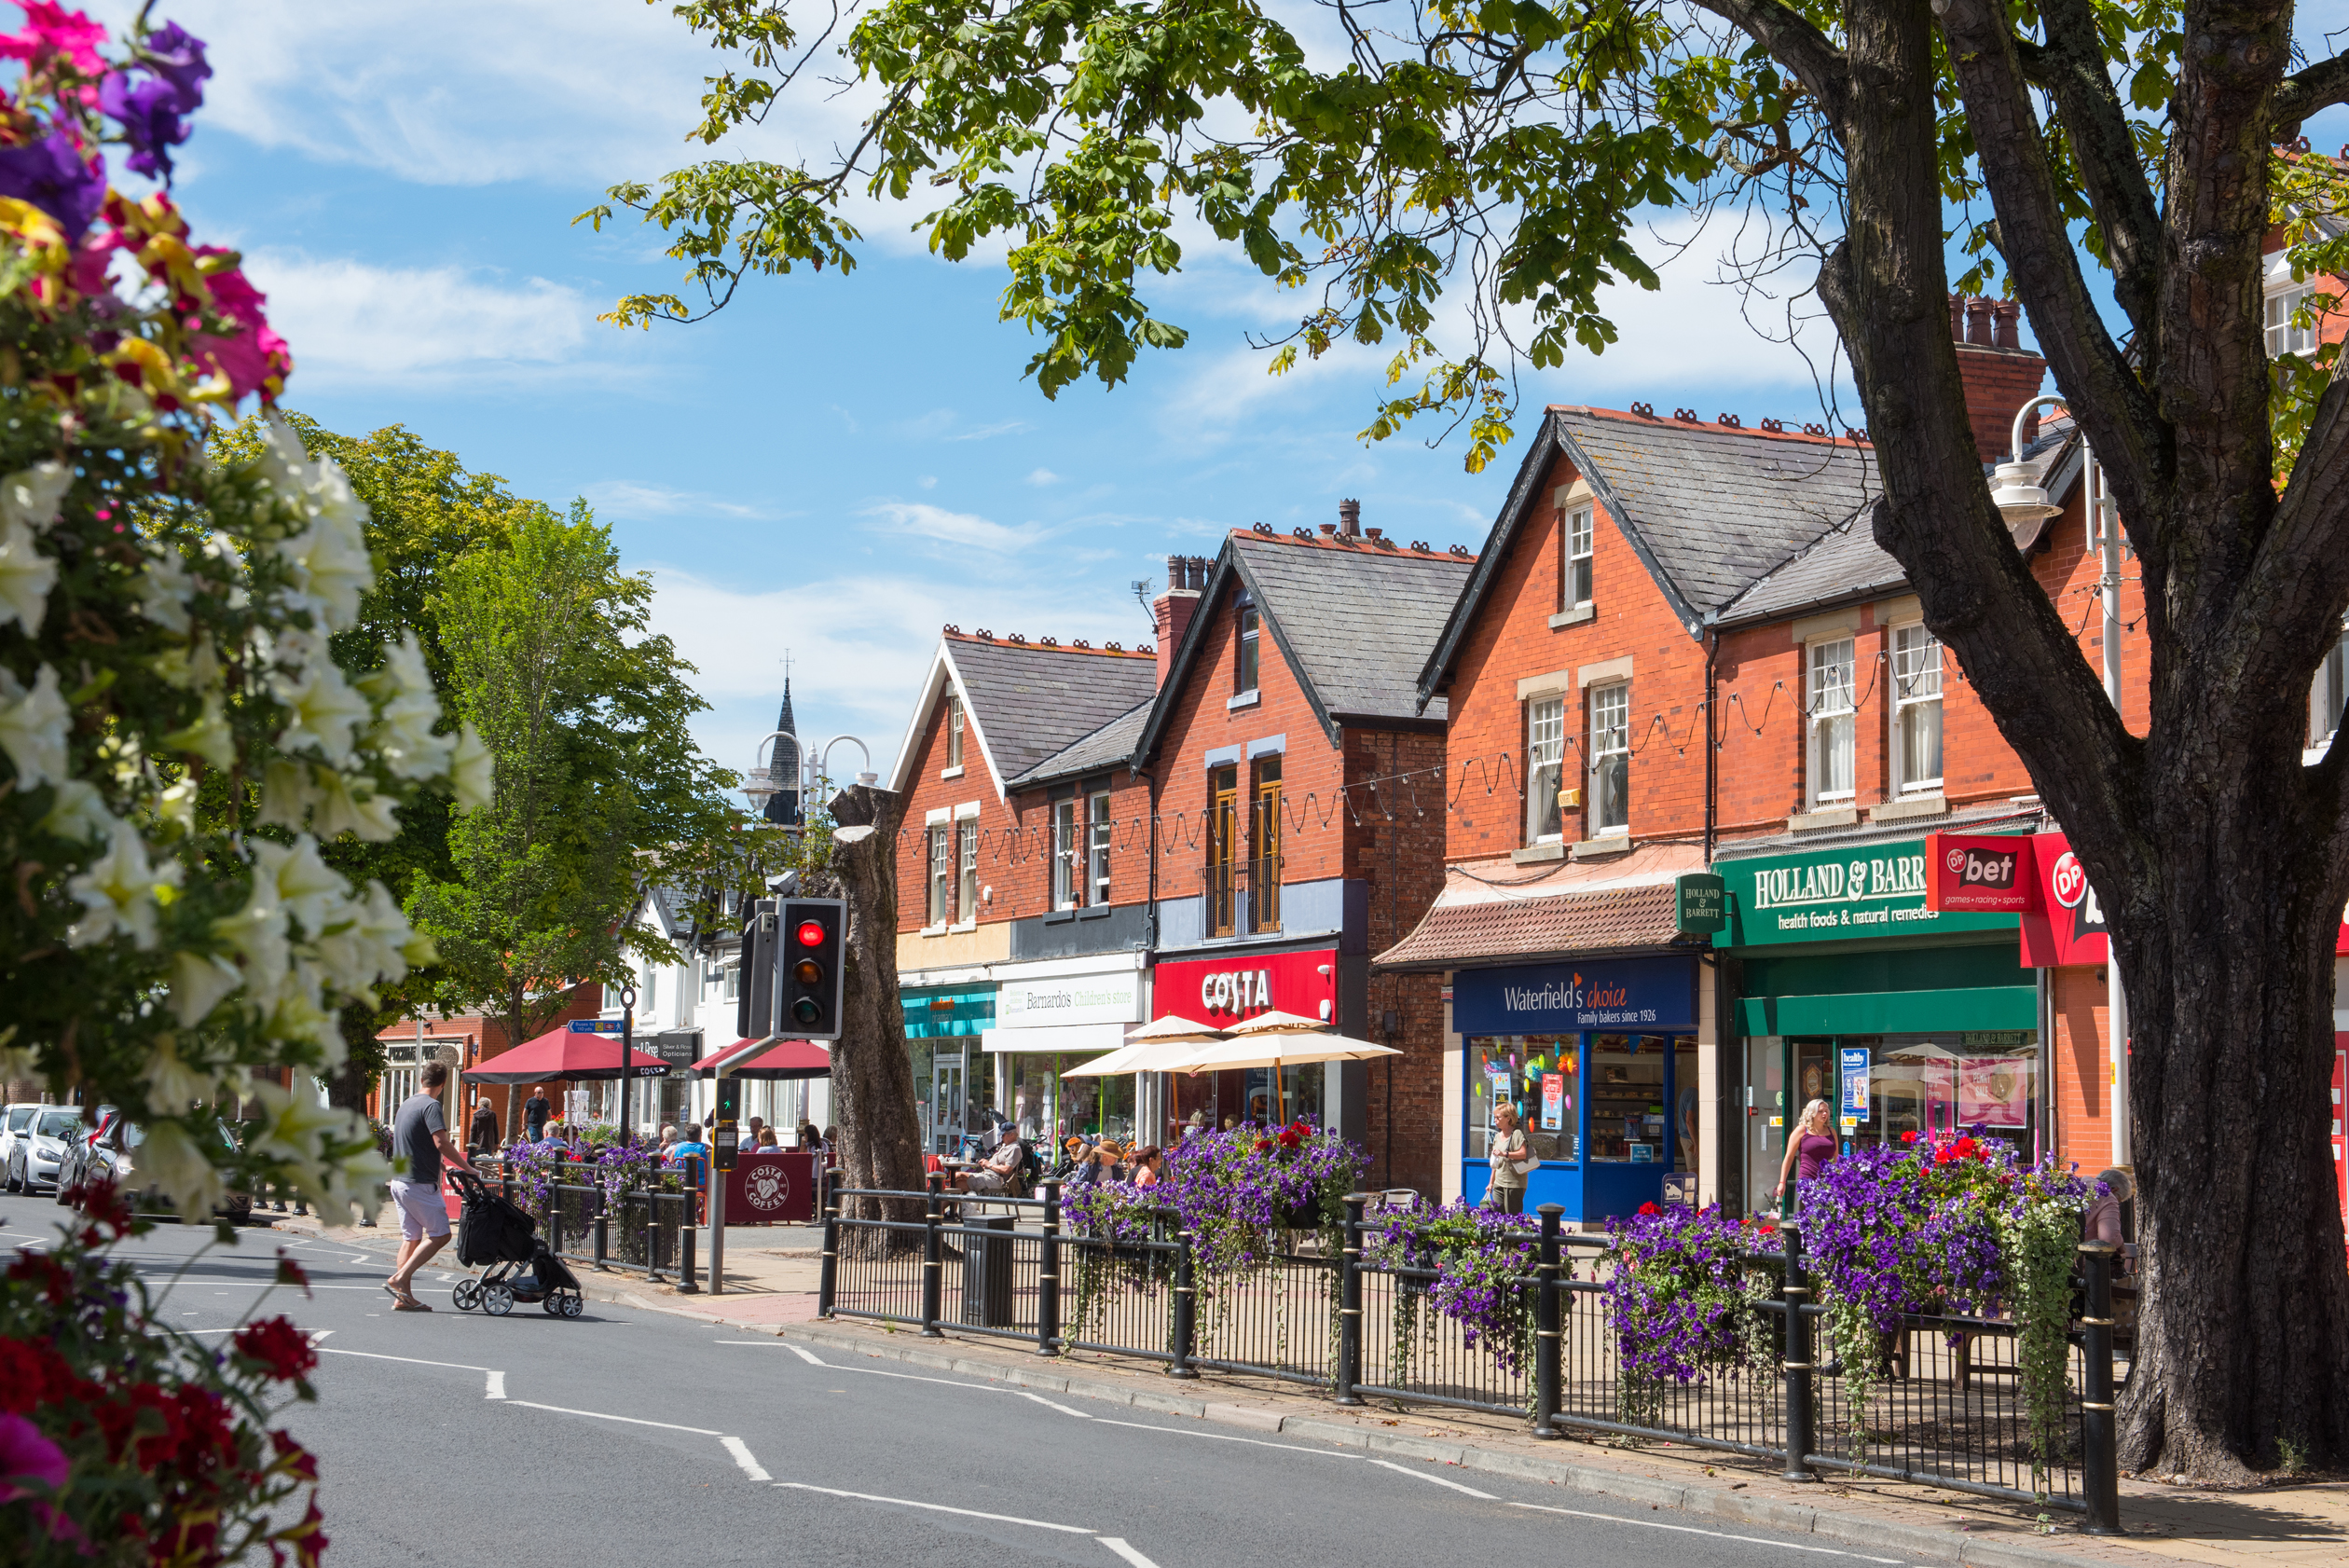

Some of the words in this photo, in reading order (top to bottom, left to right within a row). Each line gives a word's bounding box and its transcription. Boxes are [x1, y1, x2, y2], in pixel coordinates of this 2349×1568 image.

[1949, 854, 1965, 868] DP
[1965, 853, 2012, 882] bet
[1754, 862, 1846, 910] HOLLAND
[1848, 860, 1868, 901] &
[1871, 855, 1927, 894] BARR
[1685, 888, 1720, 900] HOLLAND
[1945, 896, 1971, 905] games
[1975, 896, 1999, 905] racing
[2002, 896, 2026, 905] sports
[1699, 898, 1706, 908] &
[1685, 908, 1720, 918] BARRETT
[1779, 913, 1808, 930] health
[1809, 911, 1838, 928] foods
[1841, 909, 1850, 926] &
[1853, 905, 1889, 925] natural
[1891, 903, 1940, 922] remedies
[1202, 969, 1273, 1015] COSTA
[1587, 981, 1628, 1009] choice
[1026, 990, 1071, 1010] Barnardo's
[1075, 989, 1111, 1007] Children's
[1112, 990, 1132, 1005] store
[932, 1011, 953, 1025] pharmacy
[1577, 1011, 1598, 1026] Family
[1599, 1010, 1620, 1024] bakers
[1622, 1010, 1638, 1023] since
[1640, 1010, 1656, 1022] 1926
[1965, 1033, 1990, 1044] HOLLAND
[1997, 1033, 2021, 1044] BARRETT
[1844, 1052, 1865, 1065] healthy
[640, 1066, 666, 1076] COSTA
[1928, 1063, 1936, 1071] Buy
[1973, 1072, 1990, 1083] PENNY
[1976, 1086, 1989, 1097] SALE
[751, 1166, 782, 1180] COSTA
[749, 1192, 786, 1209] COFFEE
